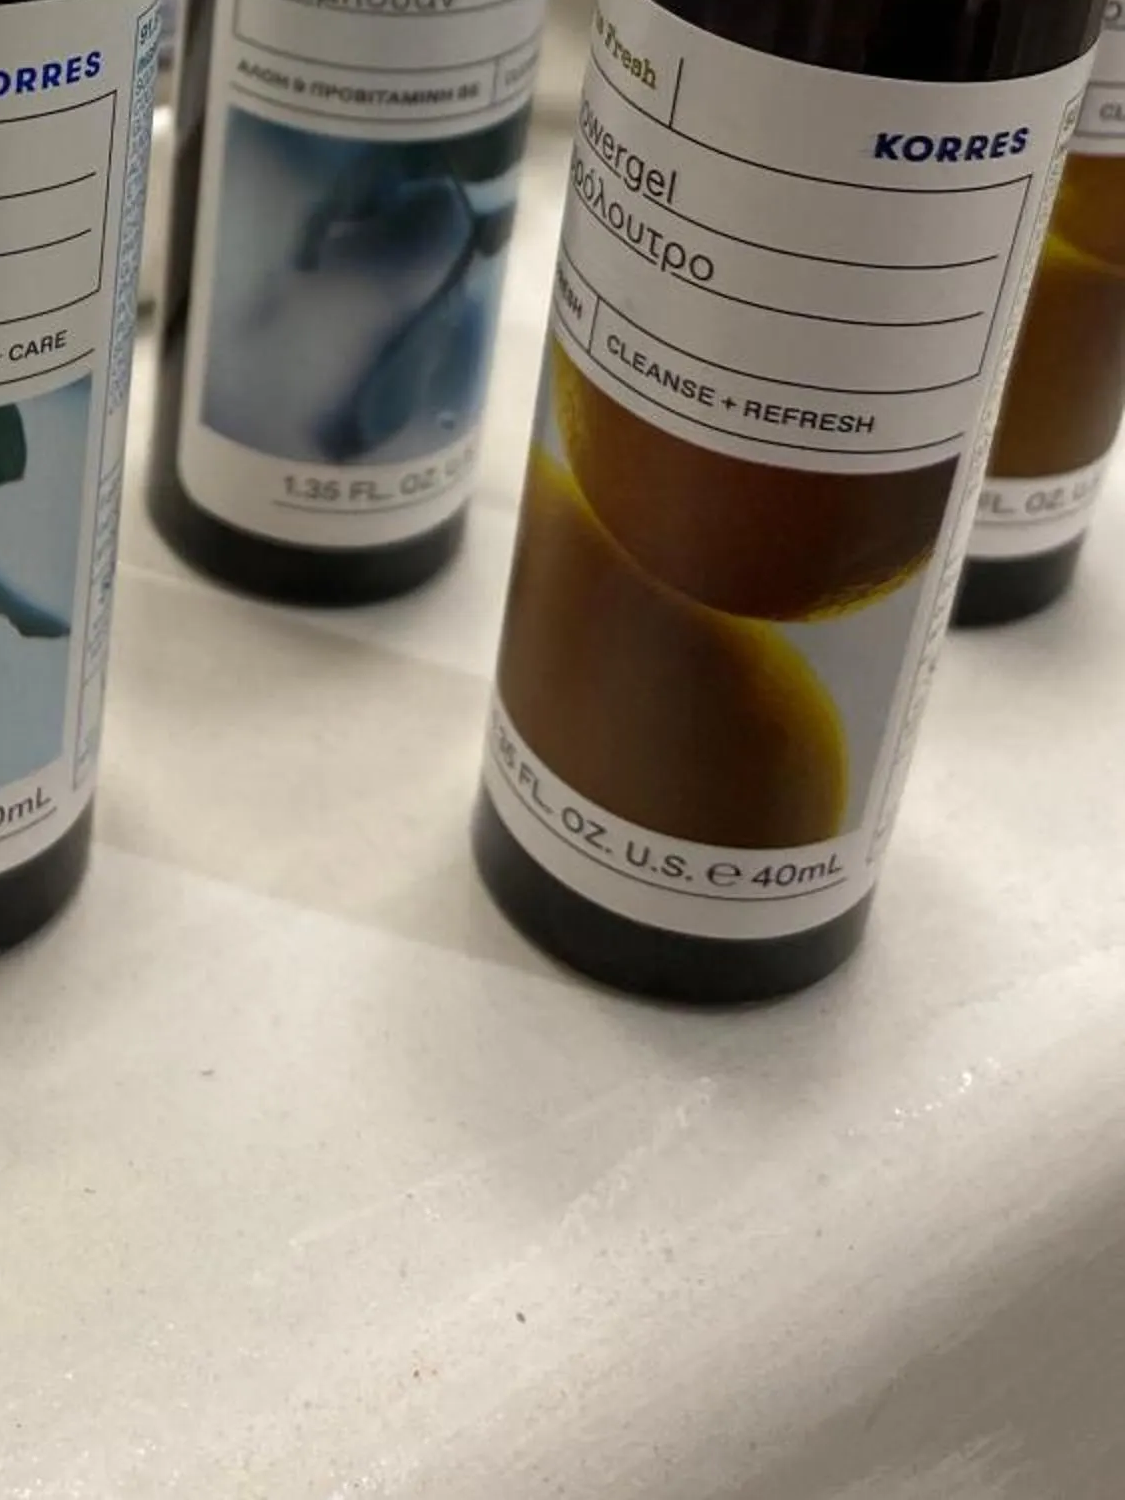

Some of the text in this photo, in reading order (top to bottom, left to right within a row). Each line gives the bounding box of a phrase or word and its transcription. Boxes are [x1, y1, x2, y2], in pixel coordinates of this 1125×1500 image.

[604, 22, 657, 92] Fresh
[873, 126, 1031, 164] KORRES
[7, 329, 69, 363] CARE
[606, 333, 876, 435] CLEANSE + REFRESH
[561, 805, 614, 855] OZ.
[625, 839, 694, 883] U.S.
[750, 853, 844, 889] 40mL
